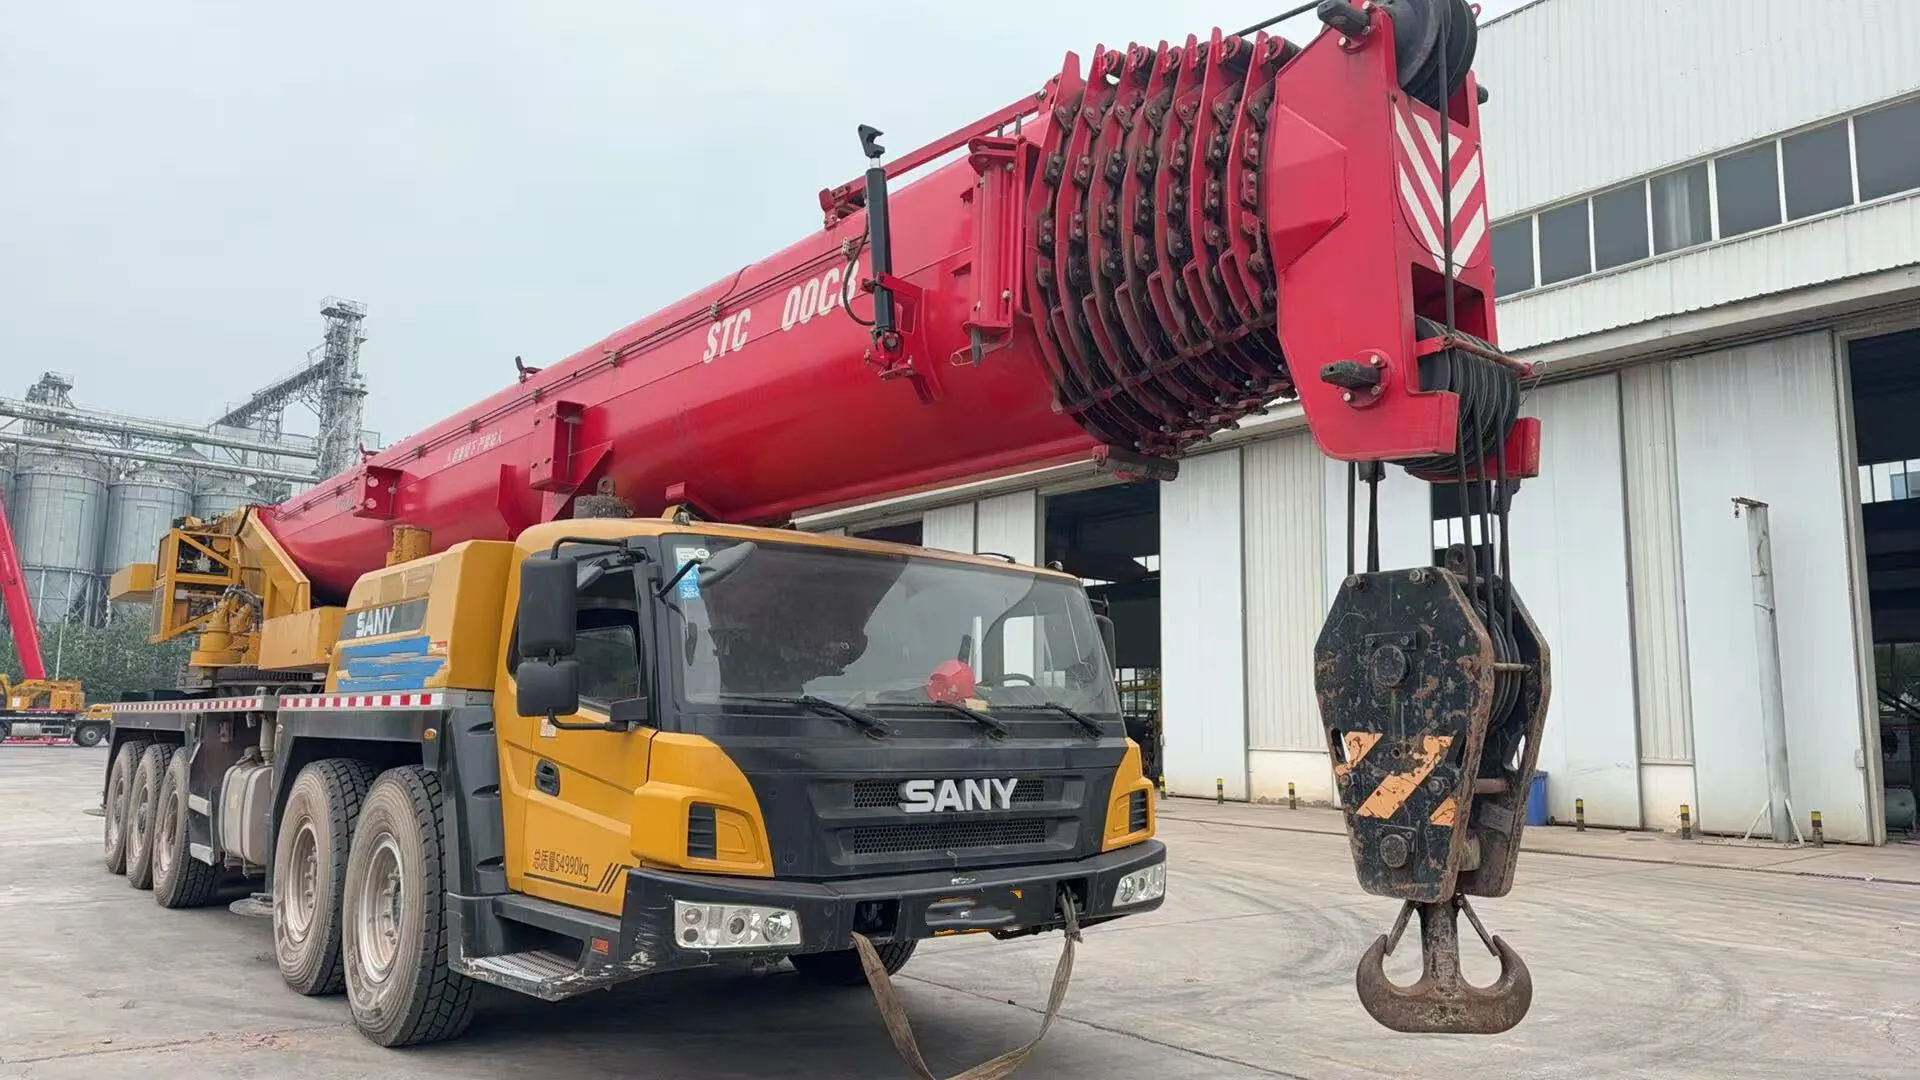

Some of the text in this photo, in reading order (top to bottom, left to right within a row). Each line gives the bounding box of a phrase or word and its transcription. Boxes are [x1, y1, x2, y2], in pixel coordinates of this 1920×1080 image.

[703, 308, 751, 363] STC
[355, 605, 396, 638] SANY
[898, 778, 1018, 813] SANY
[532, 848, 589, 883] 总质量54990kg
